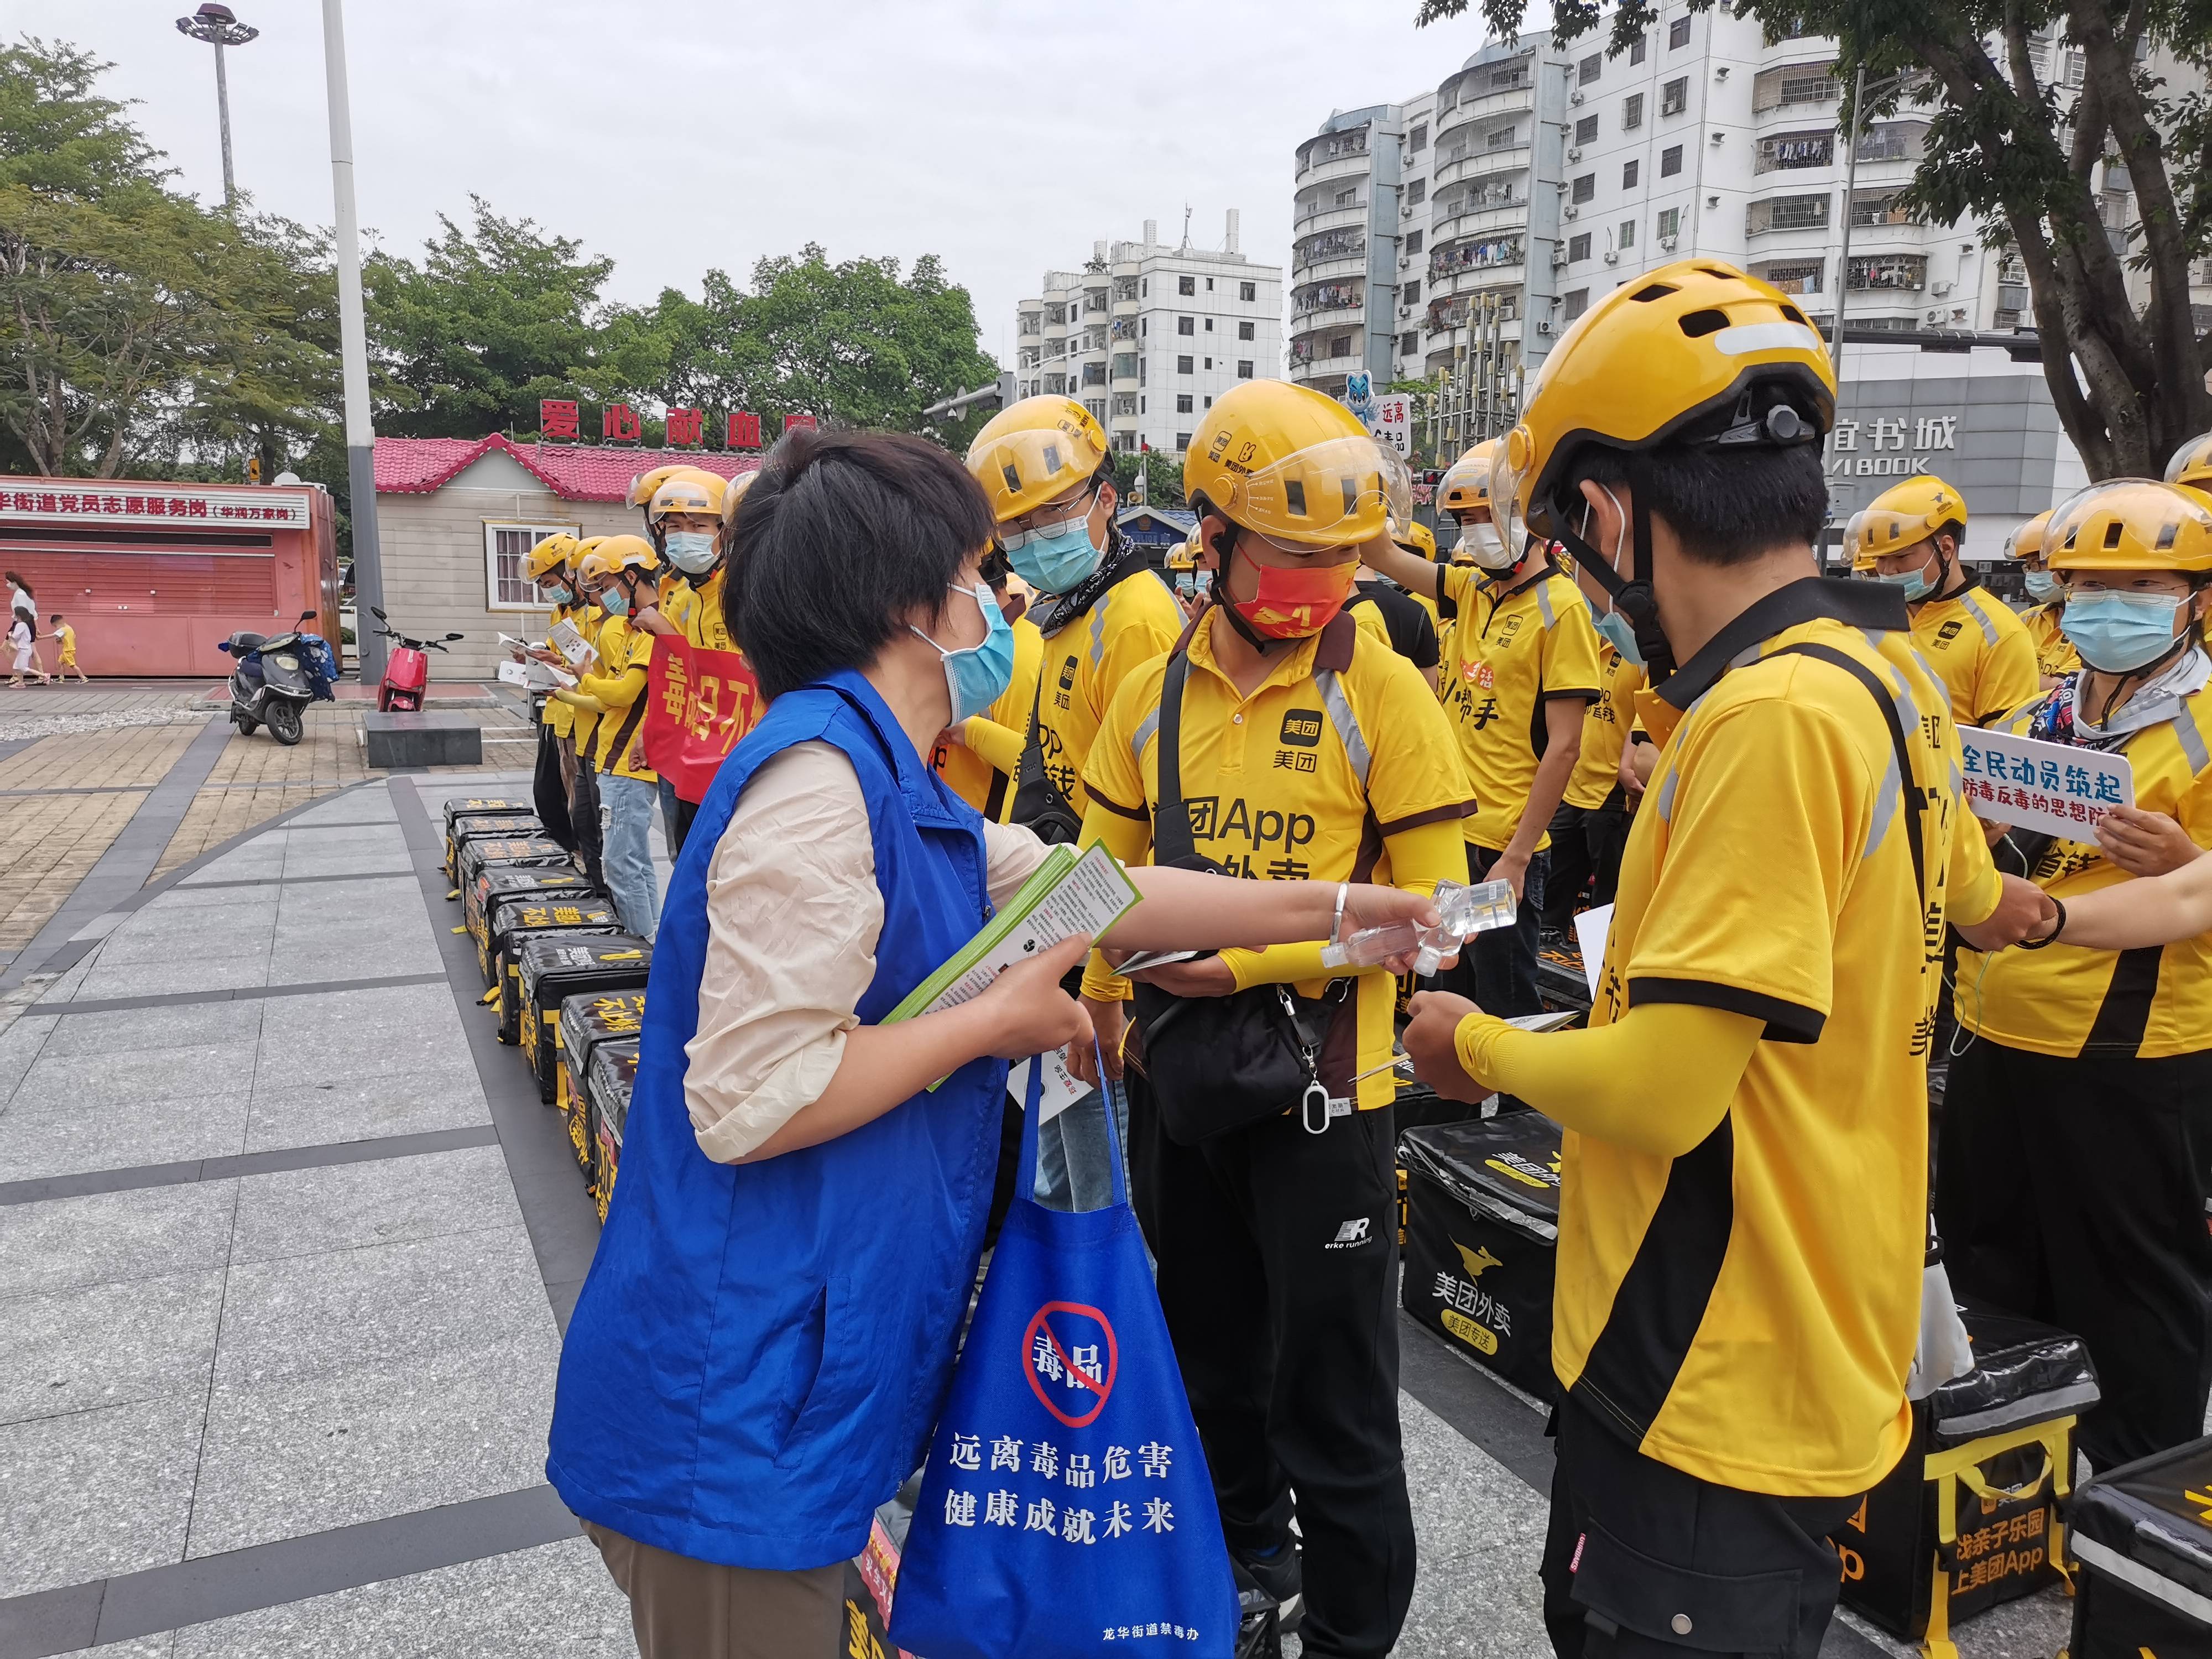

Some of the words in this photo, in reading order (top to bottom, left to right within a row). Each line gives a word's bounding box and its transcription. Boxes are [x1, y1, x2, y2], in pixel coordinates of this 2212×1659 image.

[1834, 416, 1957, 451] 宜书城
[1855, 457, 1931, 476] BOOK
[1495, 637, 1512, 648] 美团
[1931, 639, 1950, 650] 美团
[1053, 691, 1070, 710] 美团
[1284, 719, 1319, 737] 美团
[1273, 750, 1317, 773] 美团
[1963, 744, 2124, 804] 全民动员筑起
[1962, 777, 2121, 827] 防毒反毒的思想防
[1346, 1235, 1373, 1248] running
[1432, 1271, 1511, 1338] 美团外卖
[1448, 1314, 1490, 1350] 美团专送
[1033, 1334, 1102, 1389] 毒品
[950, 1432, 1173, 1489] 远离毒品危害
[944, 1488, 1175, 1545] 健康成就未来
[1950, 1547, 2043, 1595] 上美团App
[1103, 1621, 1199, 1641] 龙华街道禁毒办
